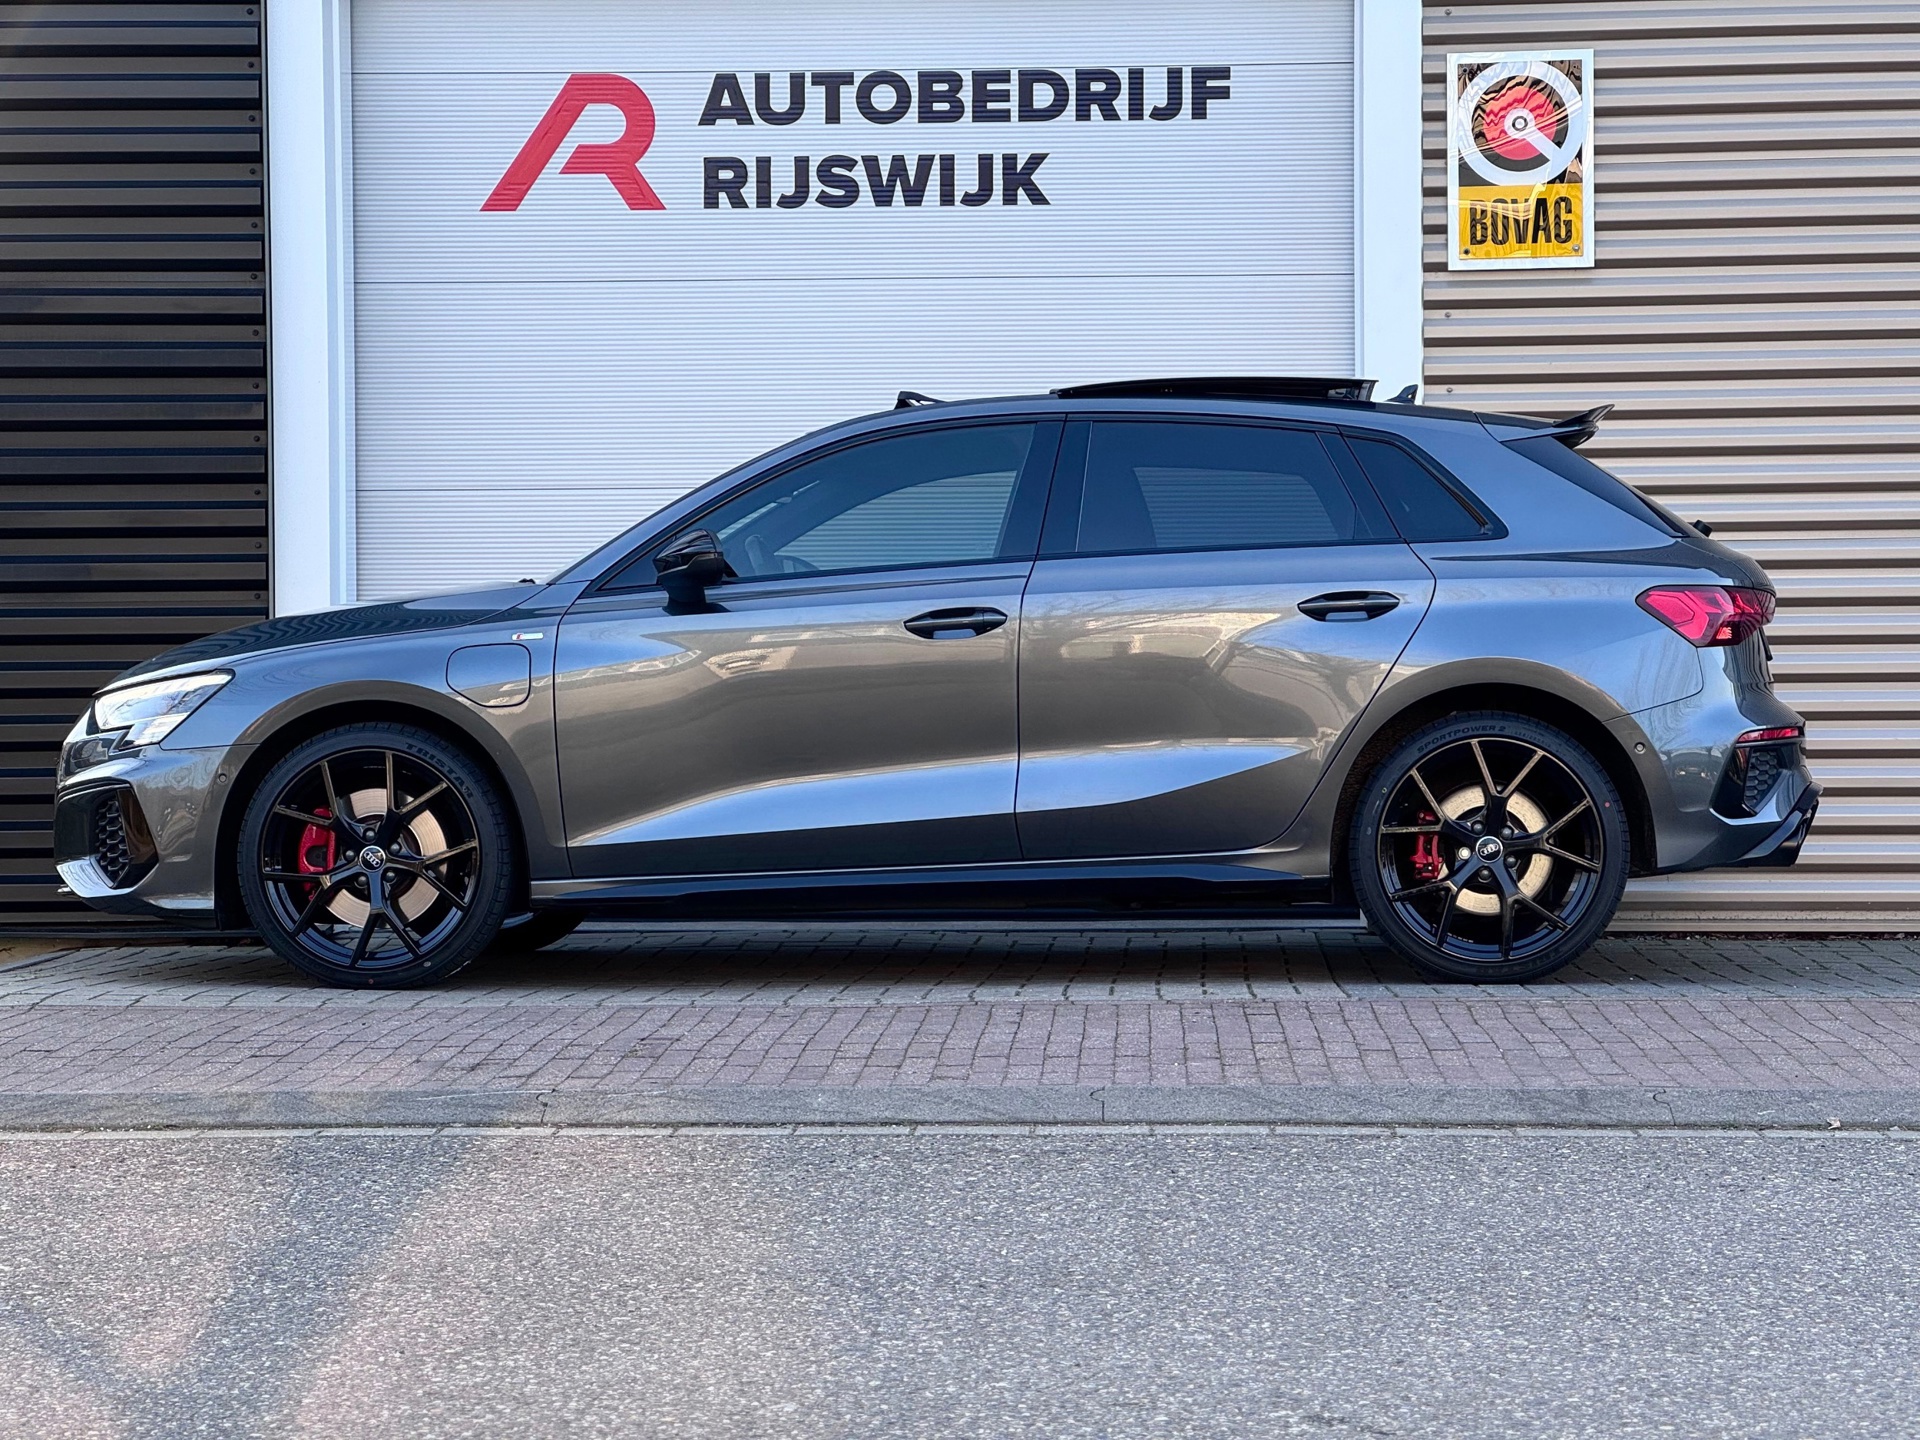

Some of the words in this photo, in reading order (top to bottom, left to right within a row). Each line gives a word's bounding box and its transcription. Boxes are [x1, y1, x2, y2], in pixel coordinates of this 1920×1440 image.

[698, 66, 1231, 126] AUTOBEDRIJF
[702, 152, 1051, 209] RIJSWIJK
[1470, 197, 1573, 245] BOVAG
[1417, 725, 1496, 753] SPORTPOWER
[406, 743, 473, 799] TRISTAR
